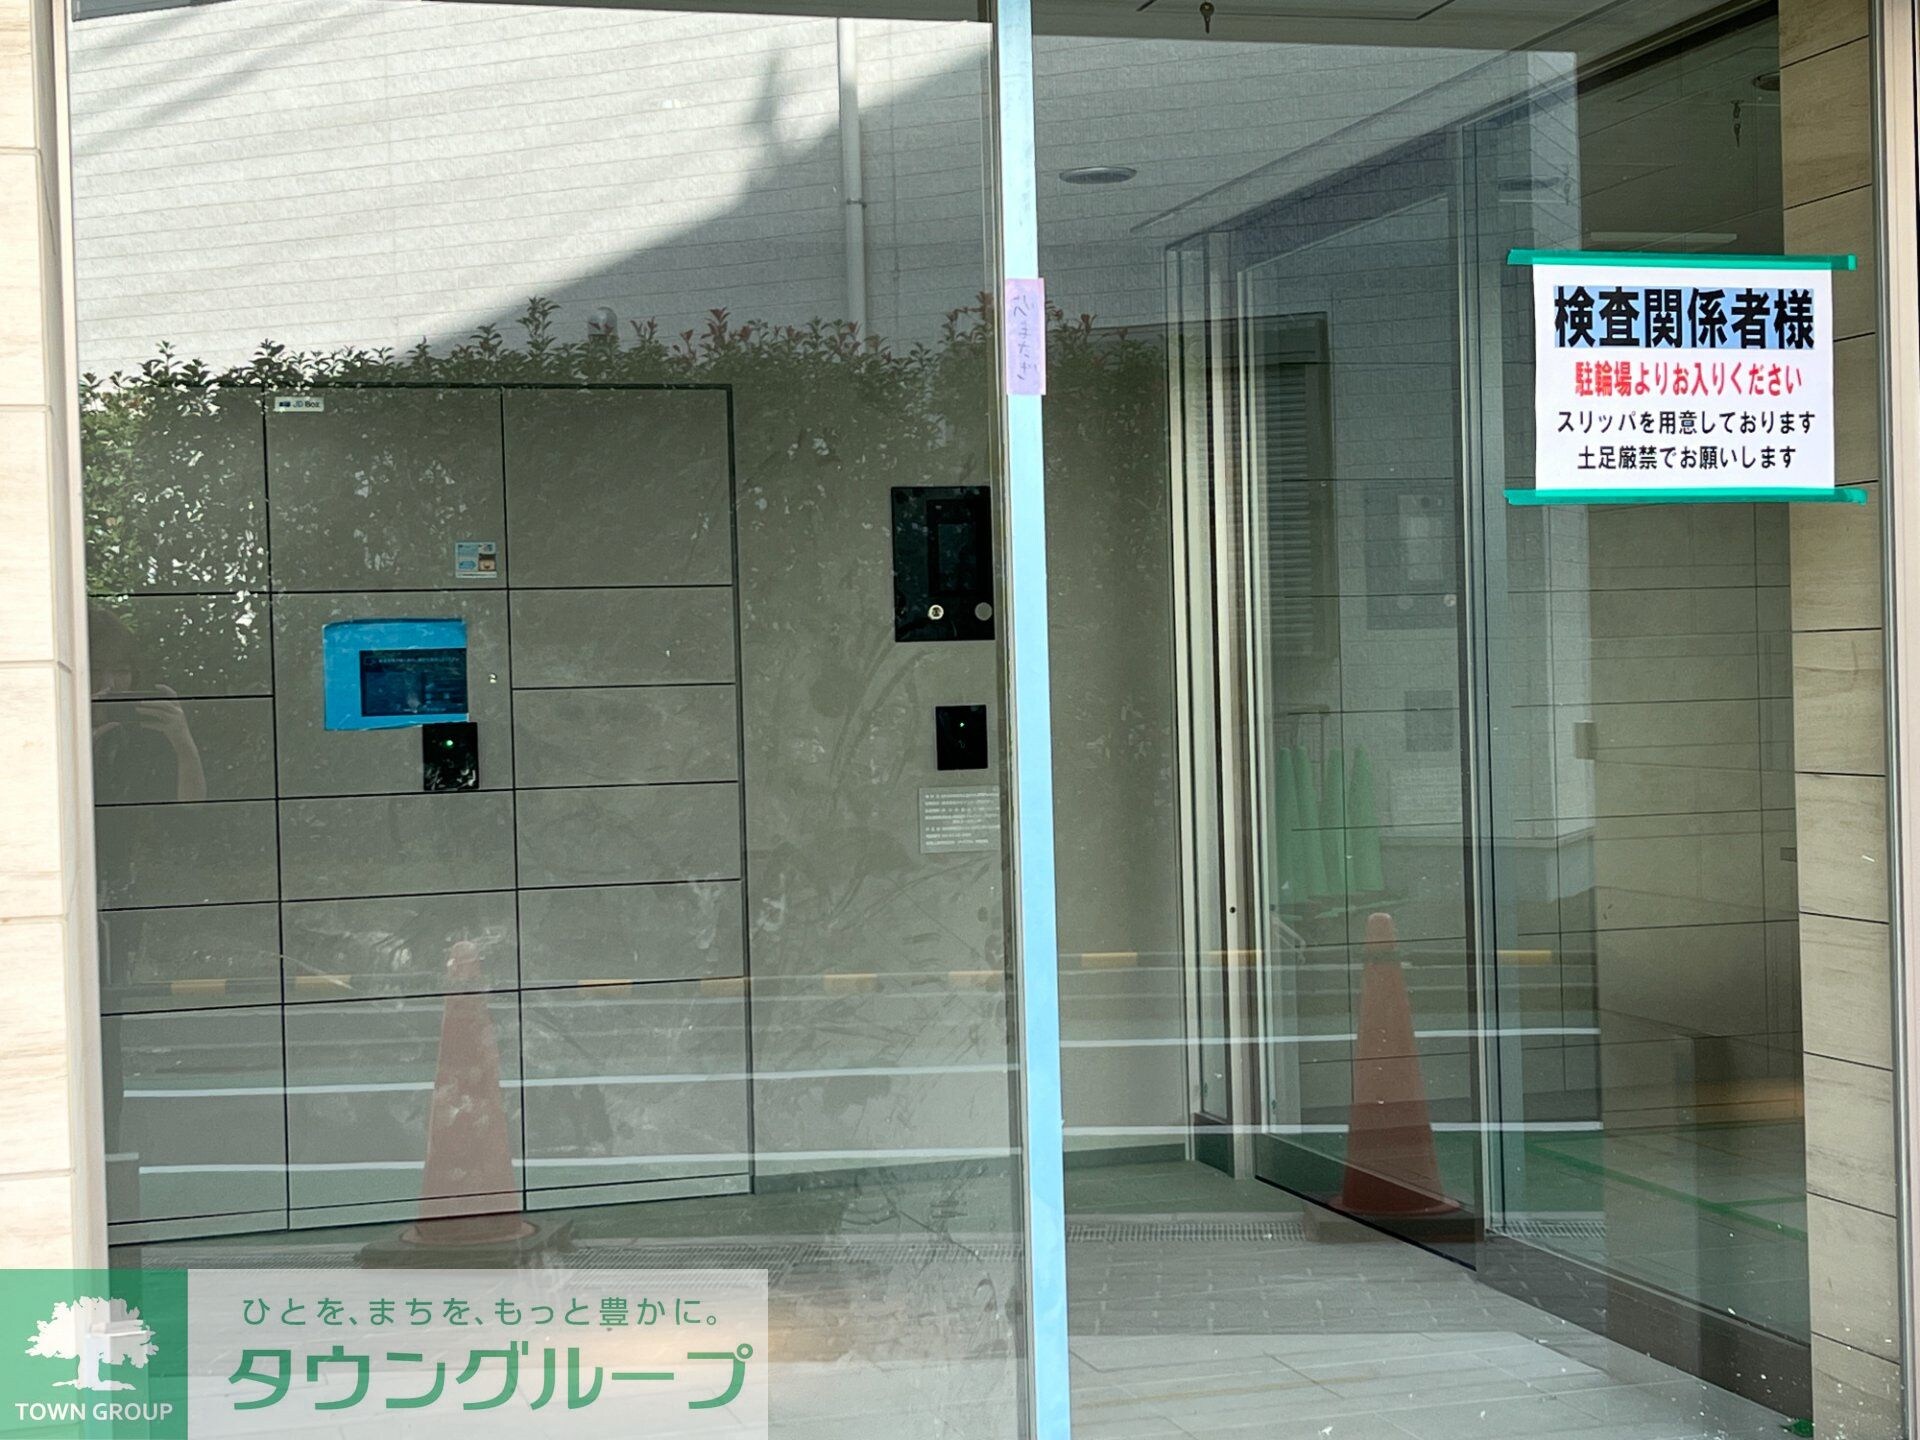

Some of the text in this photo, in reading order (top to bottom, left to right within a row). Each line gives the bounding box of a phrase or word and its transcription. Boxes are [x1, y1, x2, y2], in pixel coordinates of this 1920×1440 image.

[1554, 286, 1814, 350] 検査関係者様
[1575, 360, 1802, 397] 駐輪場よりお入りください
[1557, 410, 1815, 435] スリッパを用意しております
[1577, 445, 1796, 470] 土足厳禁でお願いします
